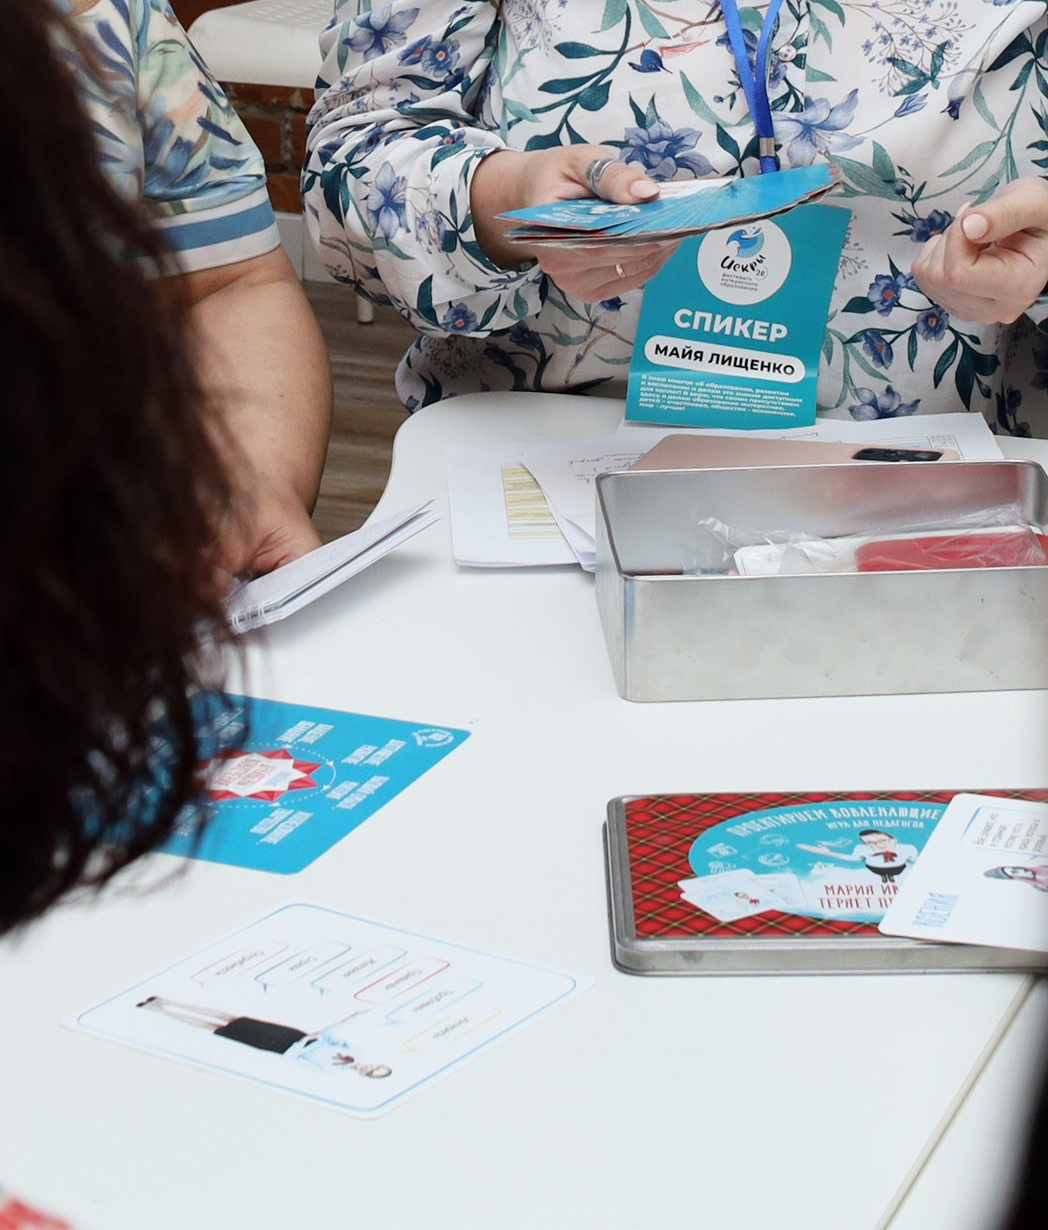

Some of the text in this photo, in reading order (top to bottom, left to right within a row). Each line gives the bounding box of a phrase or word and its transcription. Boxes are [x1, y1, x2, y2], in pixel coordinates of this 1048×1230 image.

[721, 254, 766, 272] Искры
[674, 308, 789, 343] СПИКЕР
[654, 344, 796, 376] МАЙЯ ЛИЩЕНКО
[829, 806, 941, 820] ВОВЛЕКАЮЩИЕ
[826, 819, 925, 830] ИГРА ДЛЯ ПЕДАГОГОВ
[824, 884, 875, 896] МАРИЯ
[817, 897, 872, 909] ТЕРЯЕТ
